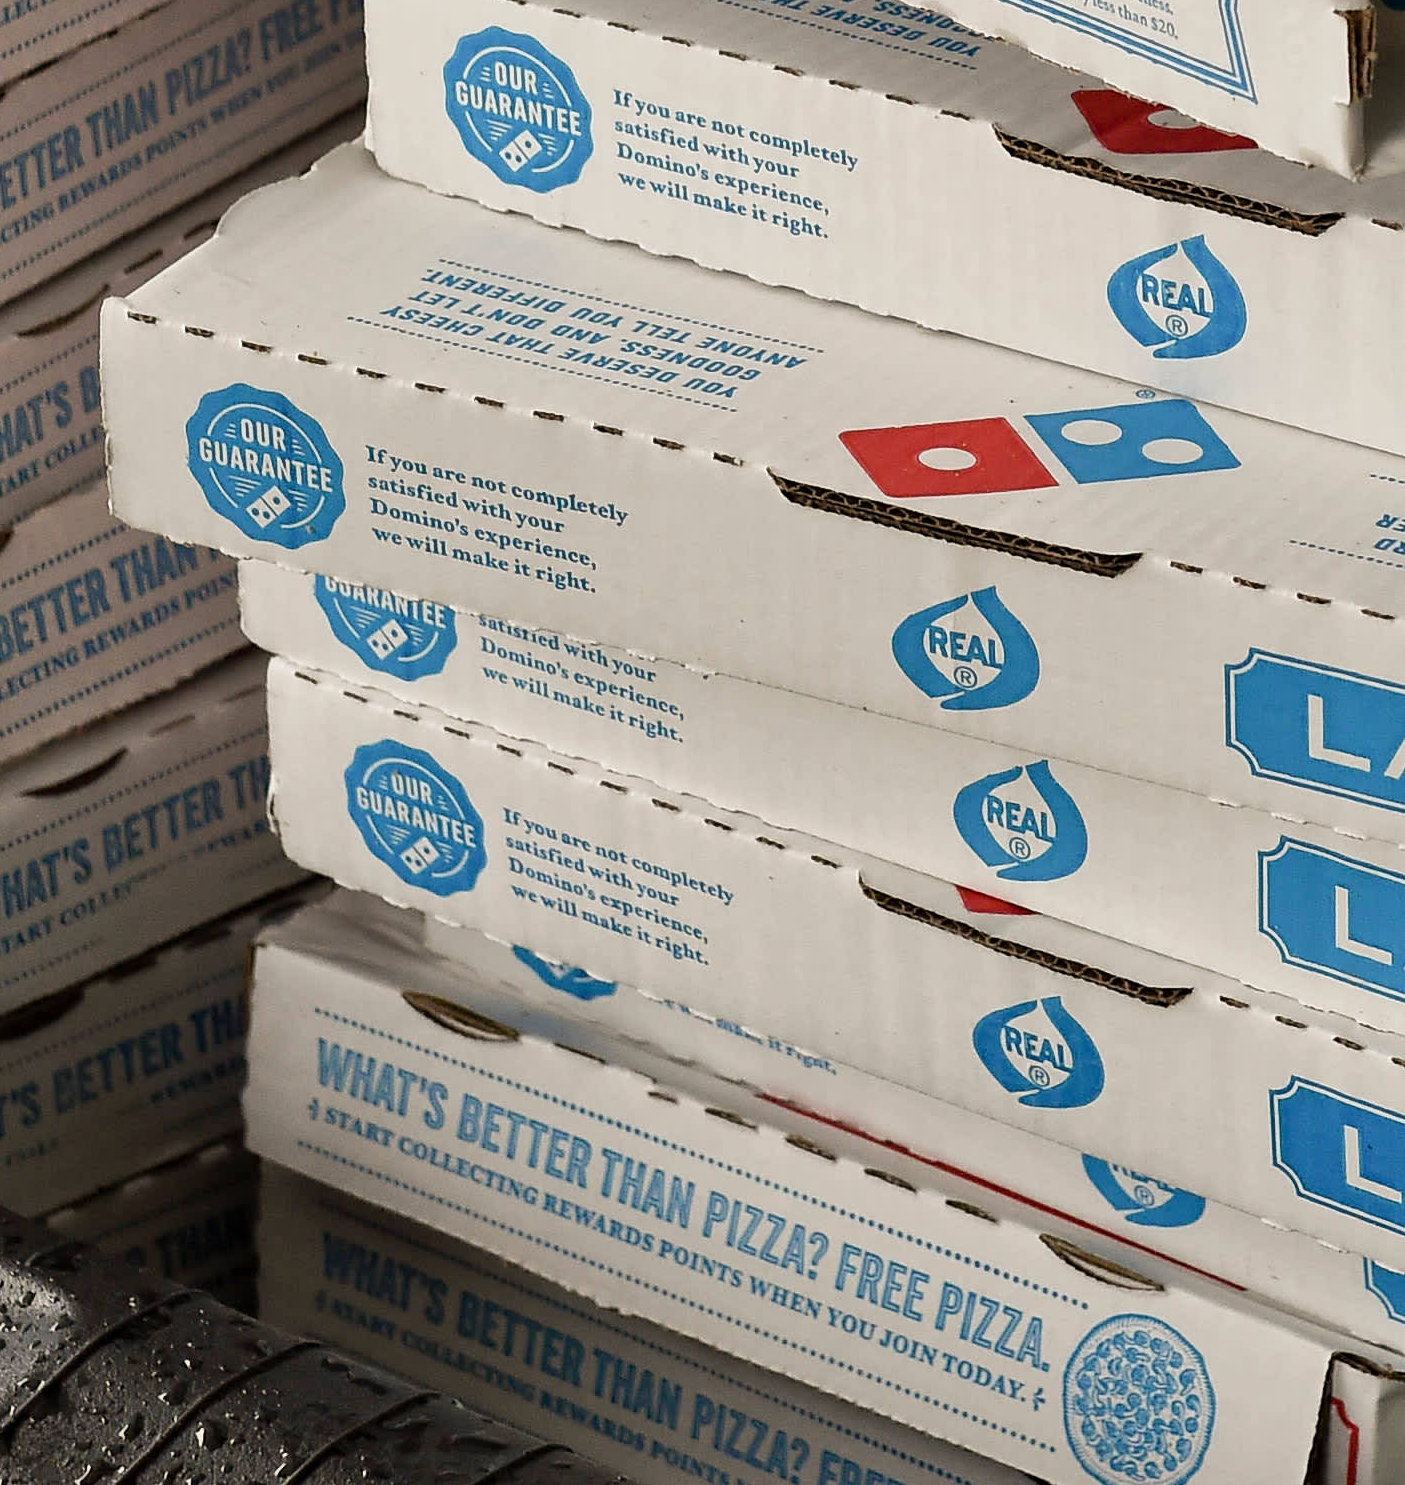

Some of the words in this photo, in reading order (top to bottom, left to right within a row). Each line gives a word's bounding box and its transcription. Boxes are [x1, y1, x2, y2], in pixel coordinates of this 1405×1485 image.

[1119, 1, 1148, 27] than
[1151, 14, 1178, 40] $20.
[1139, 274, 1212, 318] REAL
[240, 418, 286, 452] OUR
[199, 438, 333, 493] GUARANTEE
[365, 445, 389, 467] If
[389, 452, 428, 478] you
[433, 463, 467, 485] are
[471, 468, 506, 492] not
[511, 482, 629, 525] completely
[368, 473, 457, 510] satisfied
[462, 494, 511, 524] with
[515, 510, 565, 535] your
[371, 499, 469, 538] Domino's
[474, 527, 597, 570] experience,
[372, 527, 402, 548] we
[406, 529, 448, 560] will
[453, 543, 509, 574] make
[514, 557, 531, 577] it
[536, 563, 597, 595] right.
[926, 625, 1004, 667] REAL
[987, 795, 1057, 841] REAL
[1003, 1026, 1074, 1073] REAL
[316, 1036, 449, 1131] WHAT'S
[457, 1092, 593, 1191] BETTER
[602, 1147, 695, 1230] THAN
[705, 1192, 828, 1279] PIZZA?
[835, 1243, 931, 1323] FREE
[935, 1278, 1051, 1373] PIZZA.
[326, 1107, 394, 1147] START
[399, 1131, 540, 1206] COLLECTING
[542, 1194, 655, 1253] REWARDS
[659, 1237, 743, 1287] POINTS
[749, 1275, 822, 1318] WHEN
[828, 1305, 877, 1341] YOU
[881, 1326, 939, 1366] JOIN
[942, 1353, 1027, 1403] TODAY.
